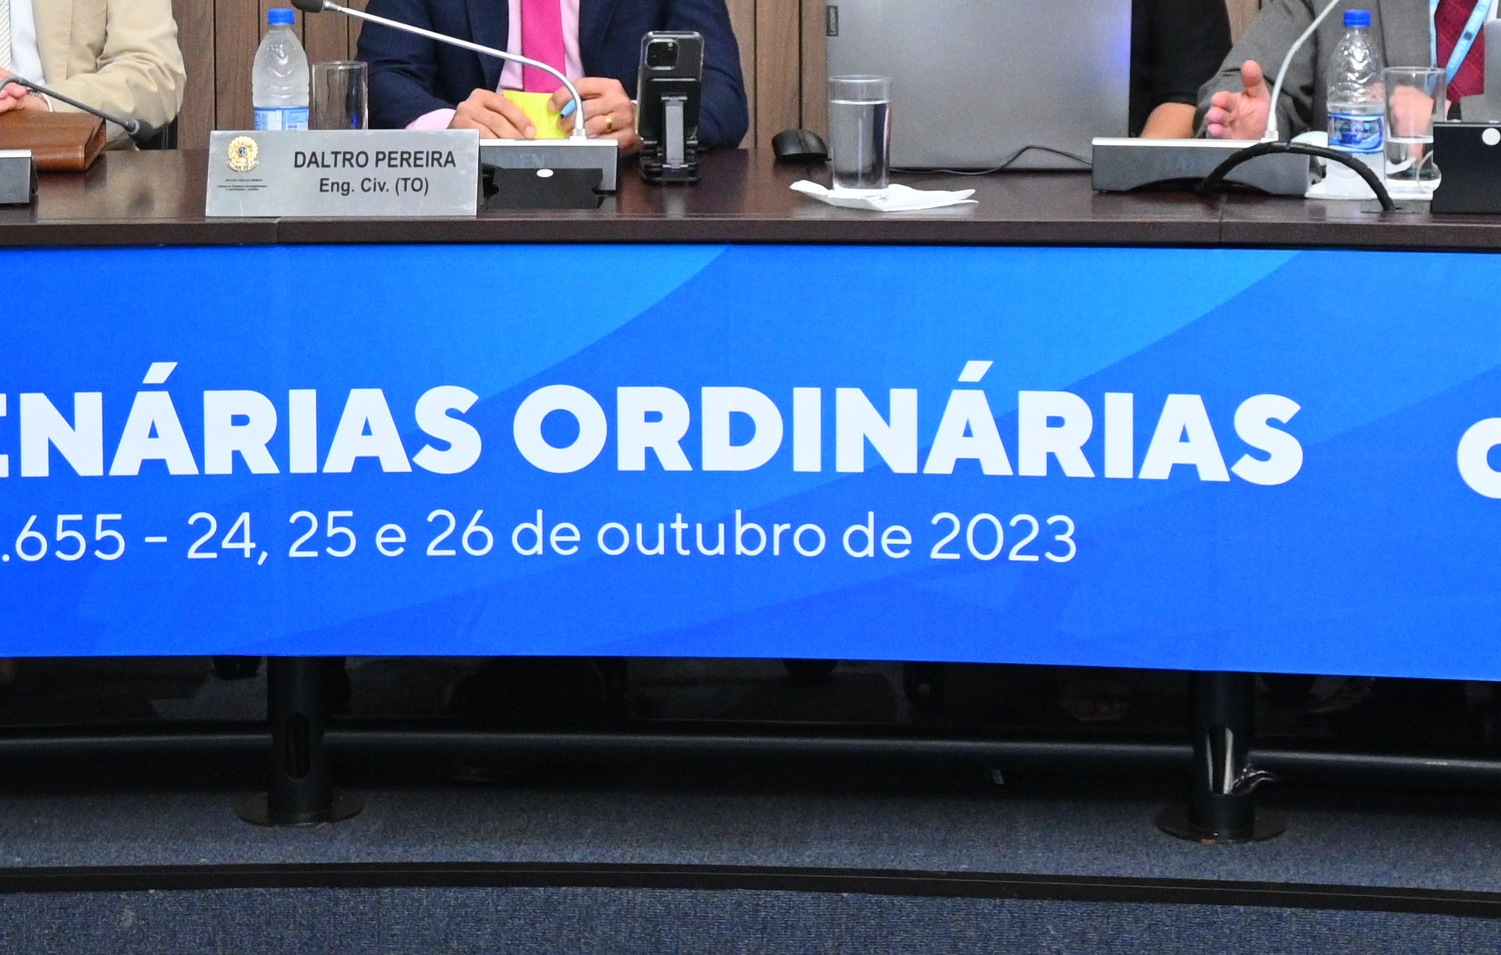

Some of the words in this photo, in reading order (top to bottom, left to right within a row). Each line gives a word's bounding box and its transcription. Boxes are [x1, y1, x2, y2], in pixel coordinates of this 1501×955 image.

[293, 150, 369, 169] DALTRO
[375, 150, 457, 169] PEREIRA
[318, 177, 355, 196] Eng.
[360, 177, 390, 193] Civ.
[394, 177, 430, 196] (TO)
[513, 360, 1304, 486] ORDINÁRIAS
[187, 511, 268, 566] 24,
[288, 510, 357, 558] 25
[375, 523, 406, 557] e
[426, 509, 494, 557] 26
[511, 509, 581, 556] de
[597, 509, 826, 557] outubro
[842, 511, 912, 559] de
[930, 512, 1077, 563] 2023
